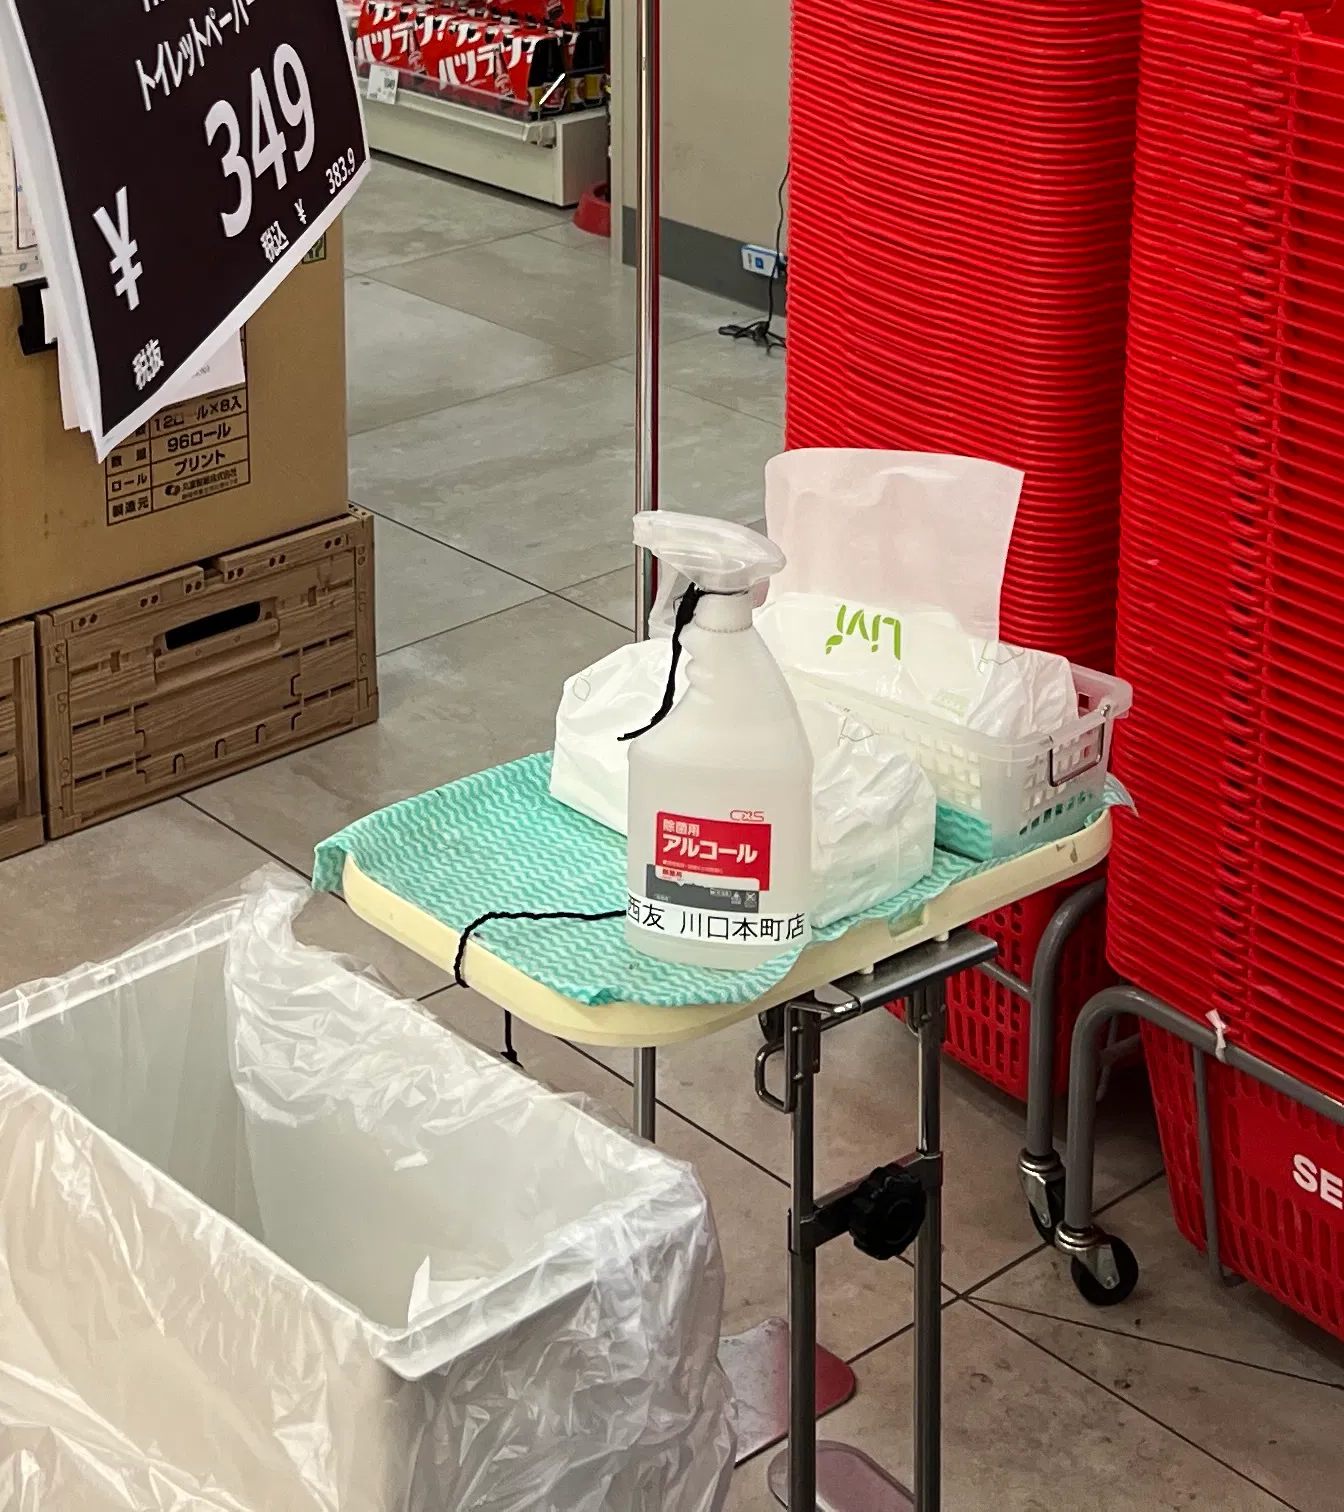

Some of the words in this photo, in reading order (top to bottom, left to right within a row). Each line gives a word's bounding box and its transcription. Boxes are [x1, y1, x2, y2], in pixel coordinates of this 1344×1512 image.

[205, 41, 318, 241] 349
[323, 147, 357, 197] 383.9
[174, 449, 226, 476] プリント
[111, 472, 148, 493] ロール
[663, 819, 700, 837] 除菌用
[662, 834, 758, 864] アルコール
[680, 911, 805, 941] 川口本町店
